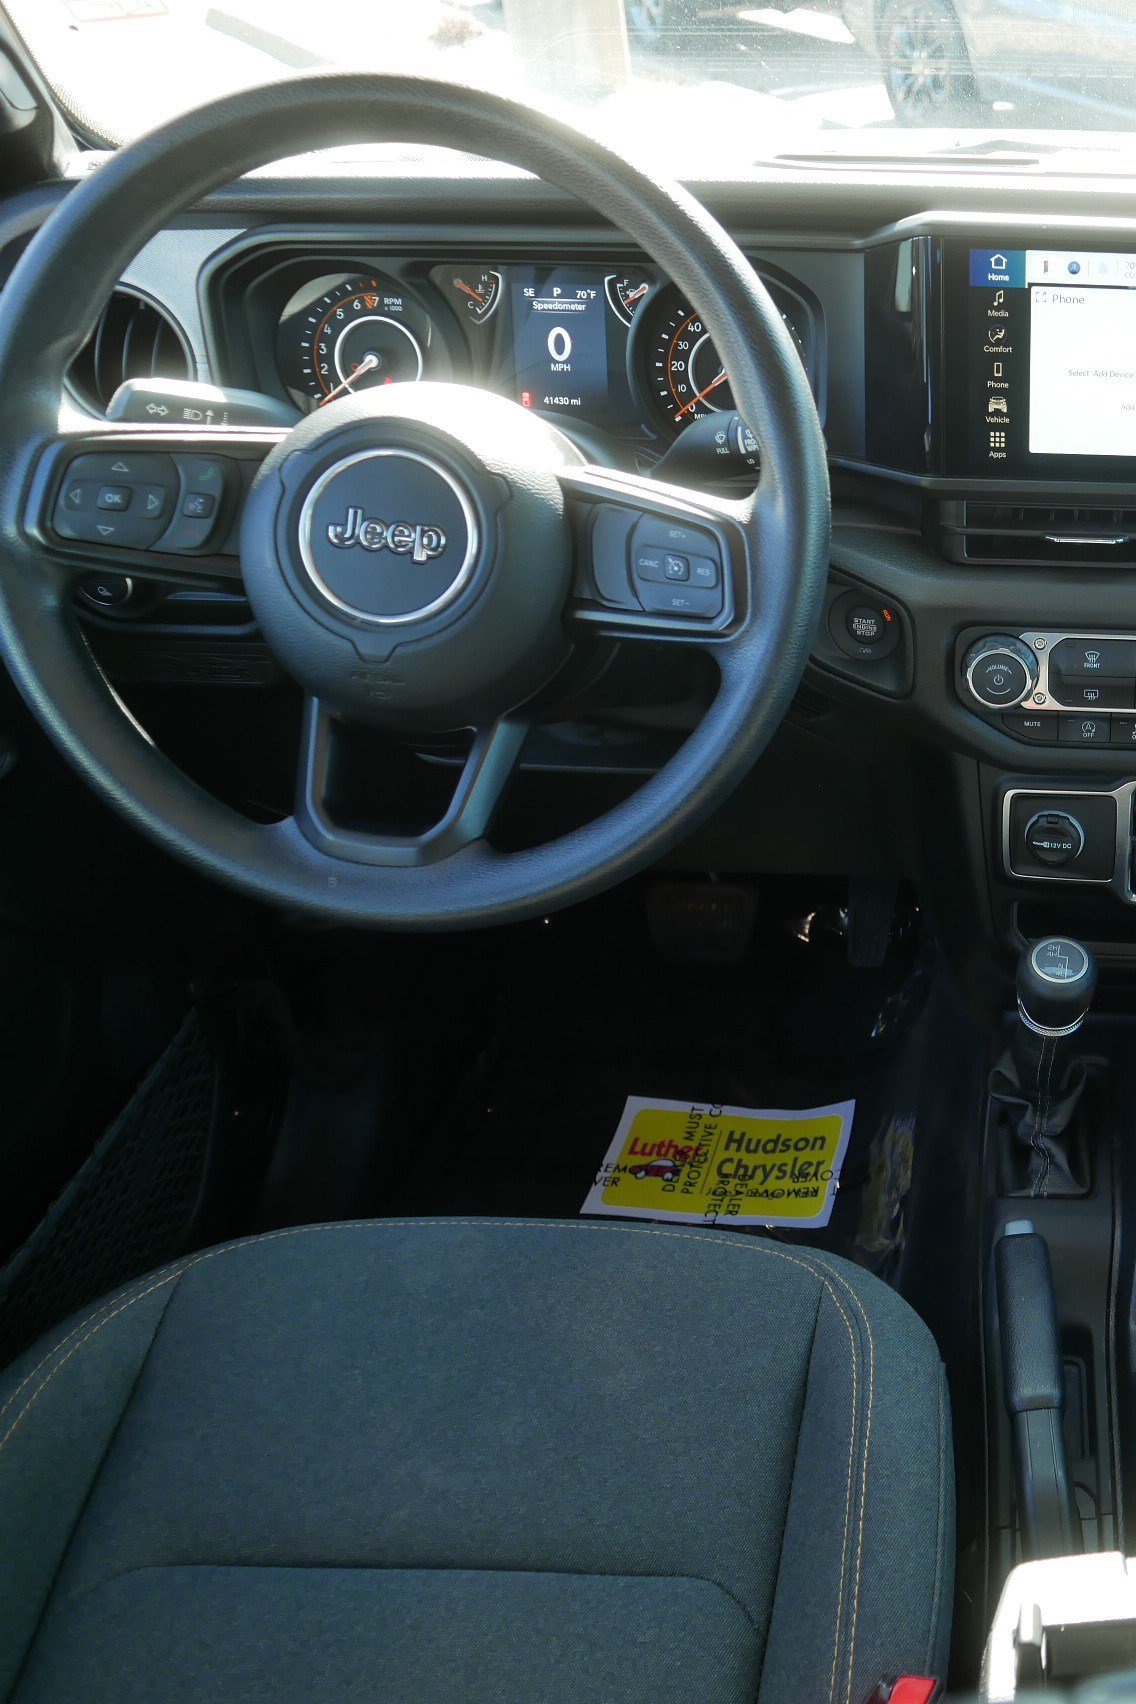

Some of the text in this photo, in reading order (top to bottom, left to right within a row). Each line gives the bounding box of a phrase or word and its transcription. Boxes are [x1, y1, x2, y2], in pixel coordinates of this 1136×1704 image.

[987, 273, 1010, 282] Home
[523, 288, 535, 297] SE
[553, 287, 562, 297] P
[383, 297, 402, 306] RPM
[1051, 293, 1085, 305] Phone
[353, 299, 362, 310] 6
[532, 301, 586, 312] Speedometer
[335, 308, 345, 320] 5
[987, 309, 1009, 318] Media
[323, 324, 332, 335] 4
[687, 322, 702, 333] 40
[318, 342, 327, 354] 3
[547, 326, 572, 363] 0
[677, 340, 689, 351] 30
[983, 345, 1013, 354] Comfort
[320, 363, 329, 375] 2
[550, 363, 572, 372] MPH
[671, 360, 685, 372] 20
[1067, 369, 1090, 378] Select
[677, 384, 687, 393] 10
[987, 380, 1010, 389] Phone
[543, 396, 581, 407] 41430 mi
[985, 415, 1010, 425] Vehicle
[988, 450, 1007, 460] Apps
[104, 493, 122, 503] OK
[327, 506, 446, 564] Jeep
[853, 617, 875, 625] START
[856, 629, 875, 637] STOP
[988, 664, 1009, 672] VOLUME
[1024, 720, 1041, 728] MUTE
[1083, 731, 1095, 739] OFF
[1050, 842, 1072, 850] 12V DC
[724, 1130, 826, 1154] Hudson
[716, 1156, 825, 1186] Chrysler
